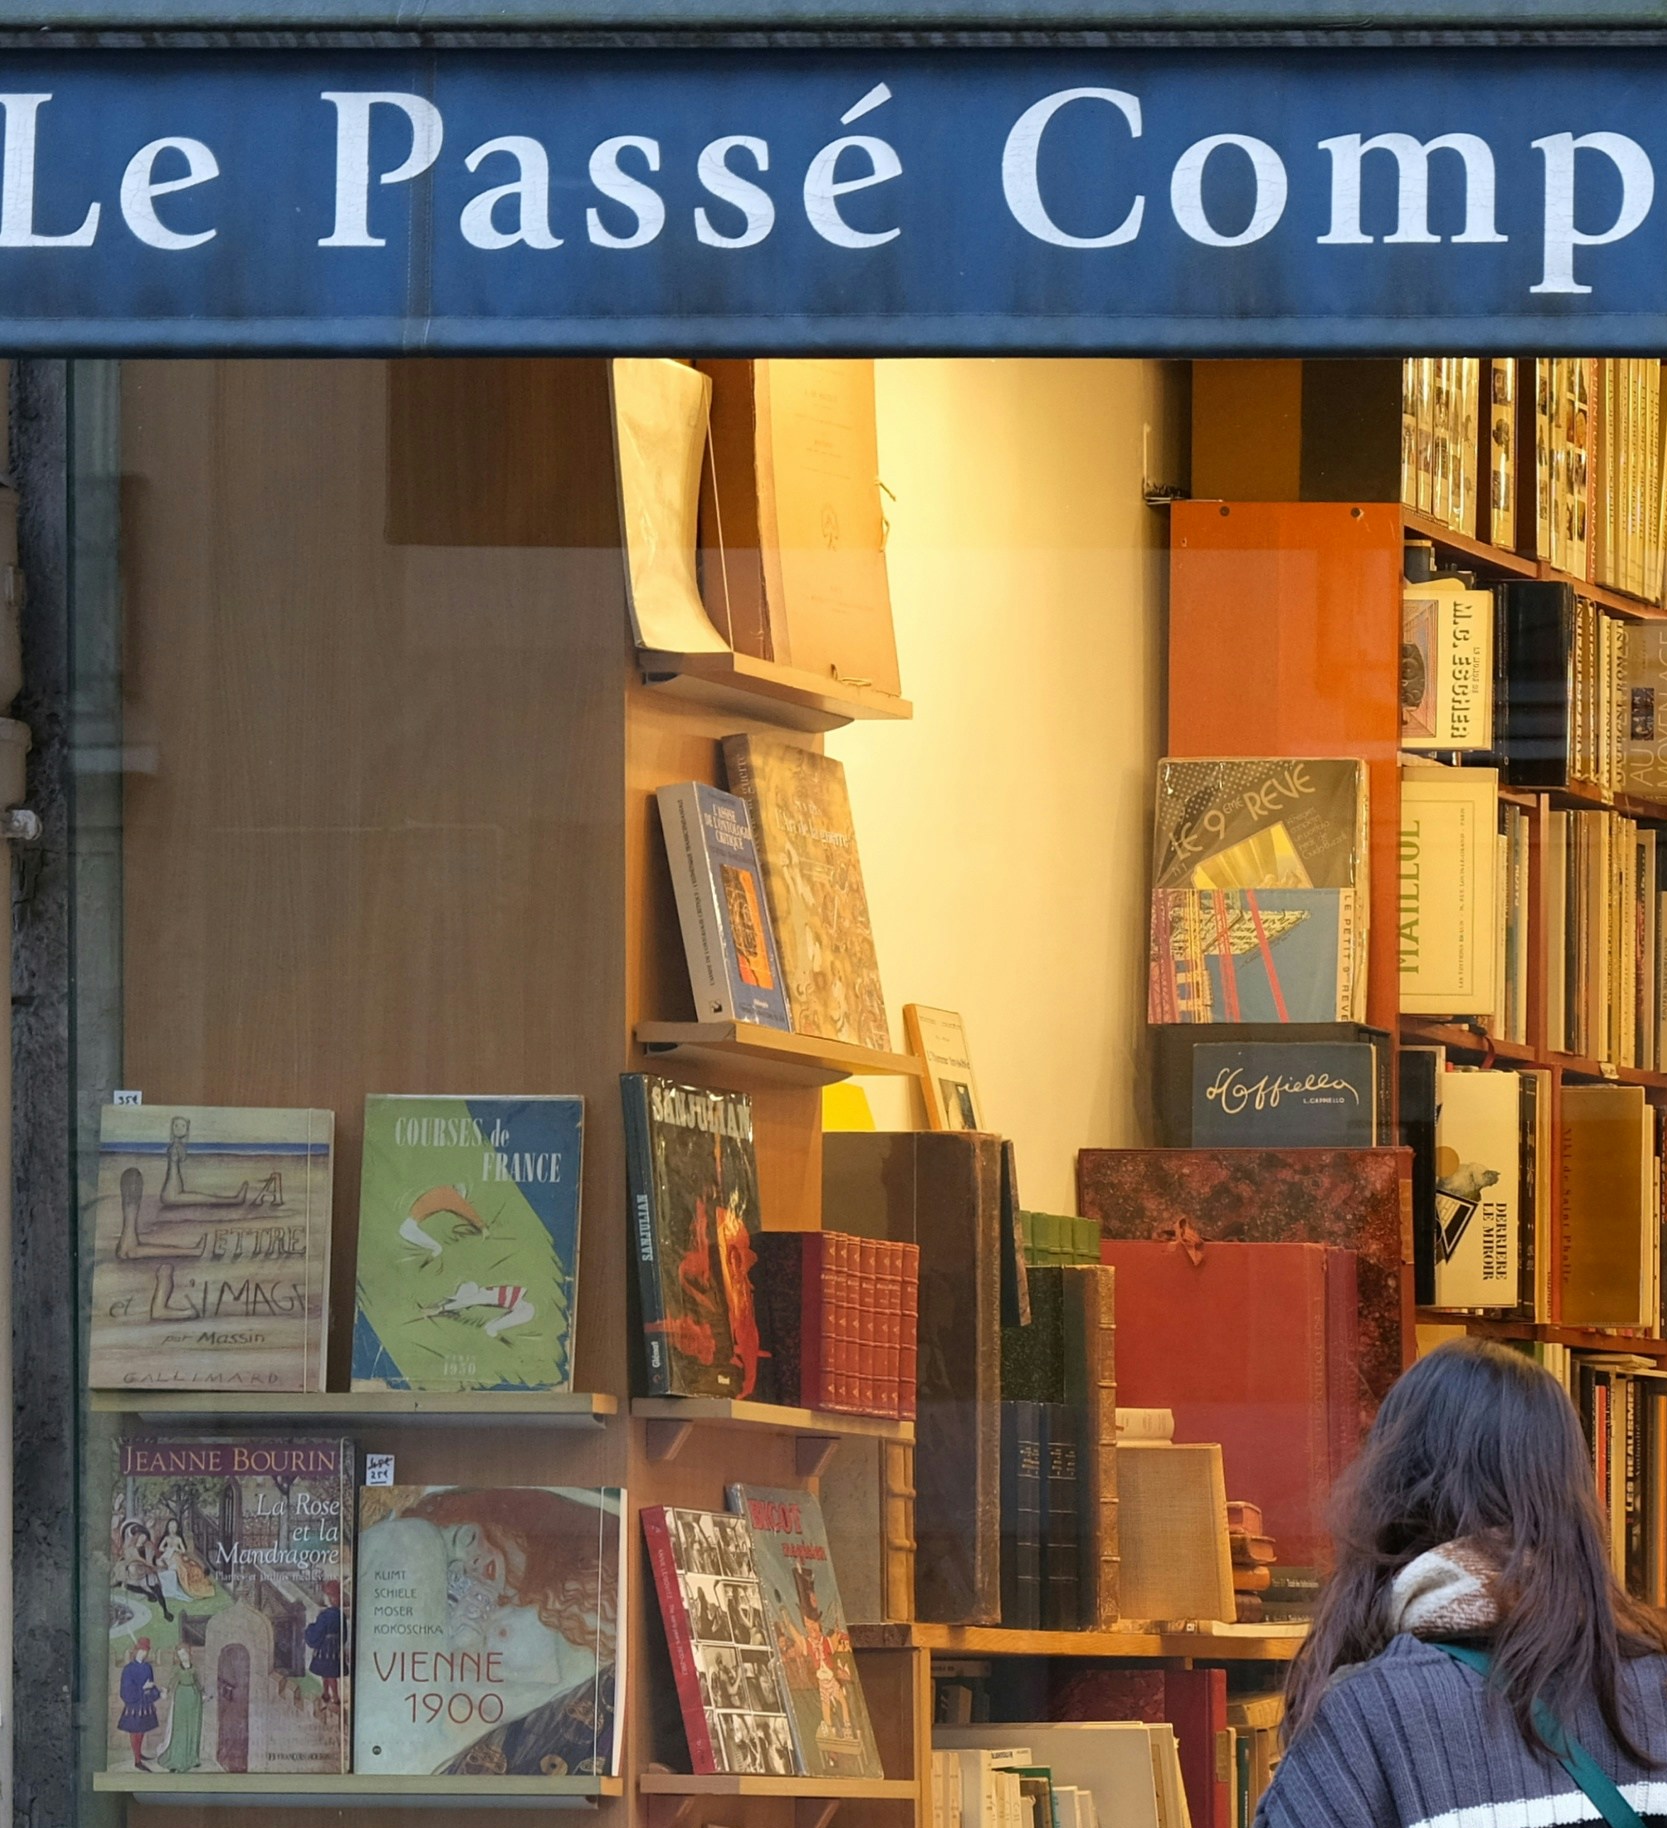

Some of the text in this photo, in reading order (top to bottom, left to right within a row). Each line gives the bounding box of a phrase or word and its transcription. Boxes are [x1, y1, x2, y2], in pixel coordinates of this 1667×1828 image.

[0, 92, 215, 252] Le
[318, 82, 904, 252] Passé
[1450, 654, 1472, 740] ESCHER
[1398, 819, 1420, 975] MAILLOL
[395, 1118, 510, 1148] COURSES de
[481, 1153, 561, 1183] FRANCE
[637, 1194, 653, 1262] SANJULIAN
[1495, 1203, 1507, 1280] DERRIERE
[124, 1372, 279, 1384] GALLIMARD
[124, 1447, 335, 1473] JEANNE BOURIN
[258, 1493, 340, 1515] La Rose
[215, 1543, 339, 1567] Mandragore
[374, 1569, 406, 1581] KLIMT
[374, 1587, 417, 1599] SCHIELE
[374, 1606, 413, 1618] MOSER
[373, 1624, 443, 1635] KOKOSCHKA
[373, 1651, 504, 1684] VIENNE
[405, 1693, 503, 1723] 1900
